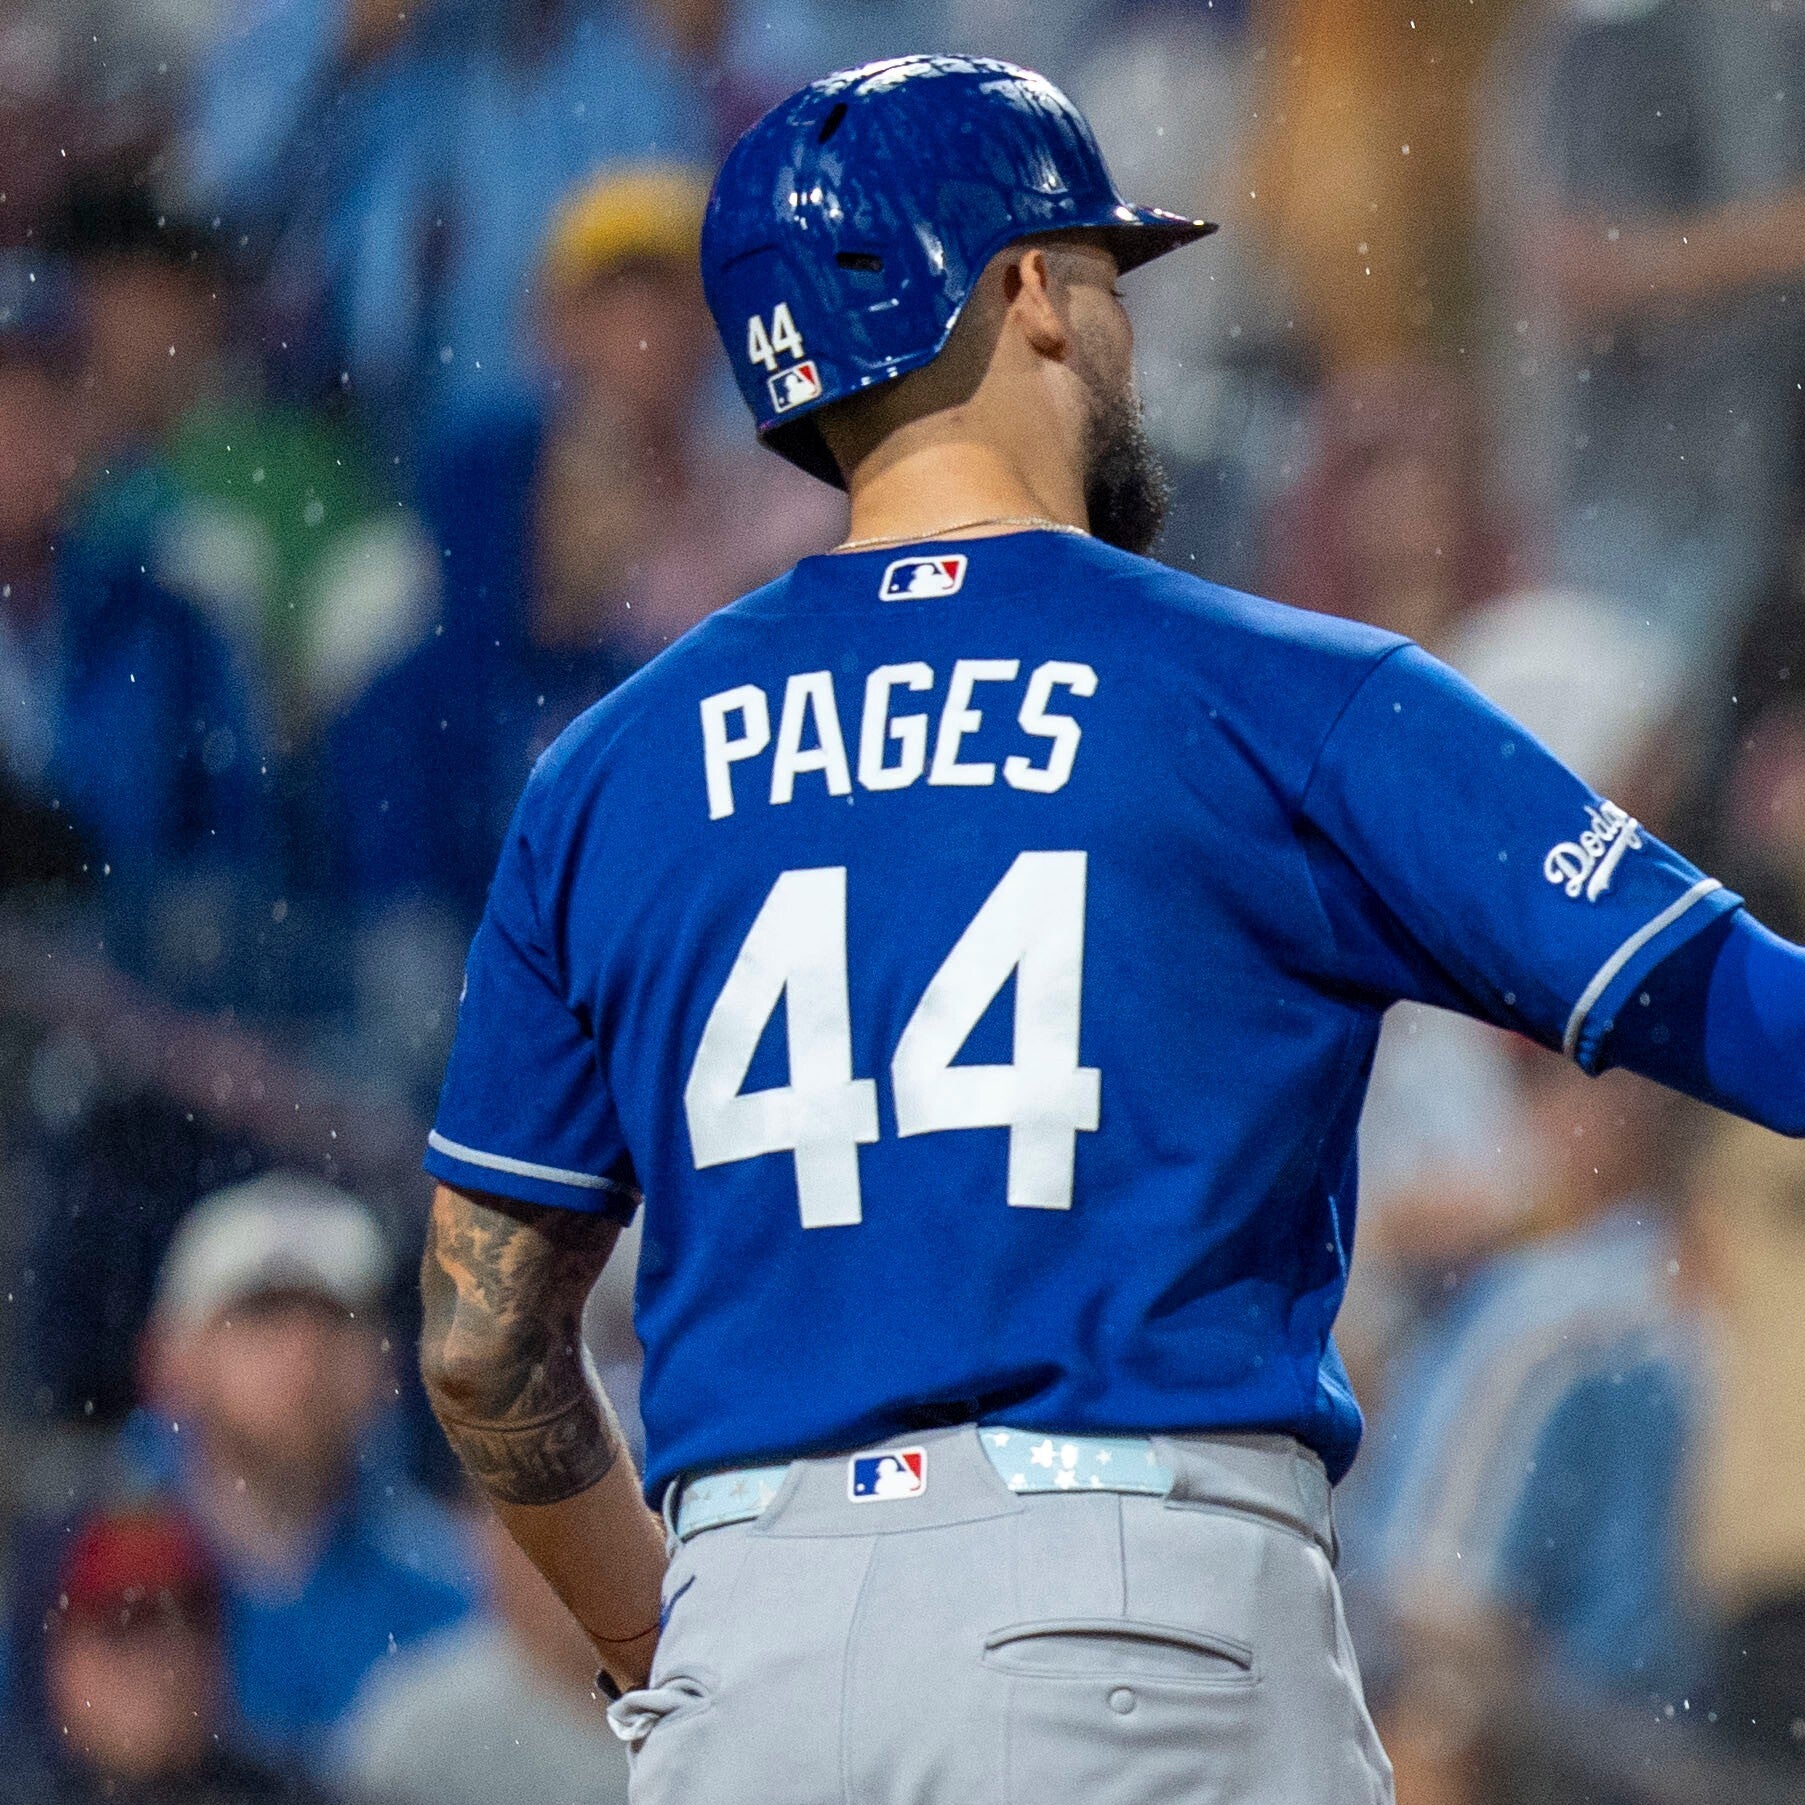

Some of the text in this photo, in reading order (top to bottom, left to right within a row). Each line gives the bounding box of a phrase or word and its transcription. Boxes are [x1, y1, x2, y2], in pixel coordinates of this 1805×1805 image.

[747, 301, 805, 371] 44
[700, 659, 1098, 820] PAGES
[685, 850, 1101, 1229] 44
